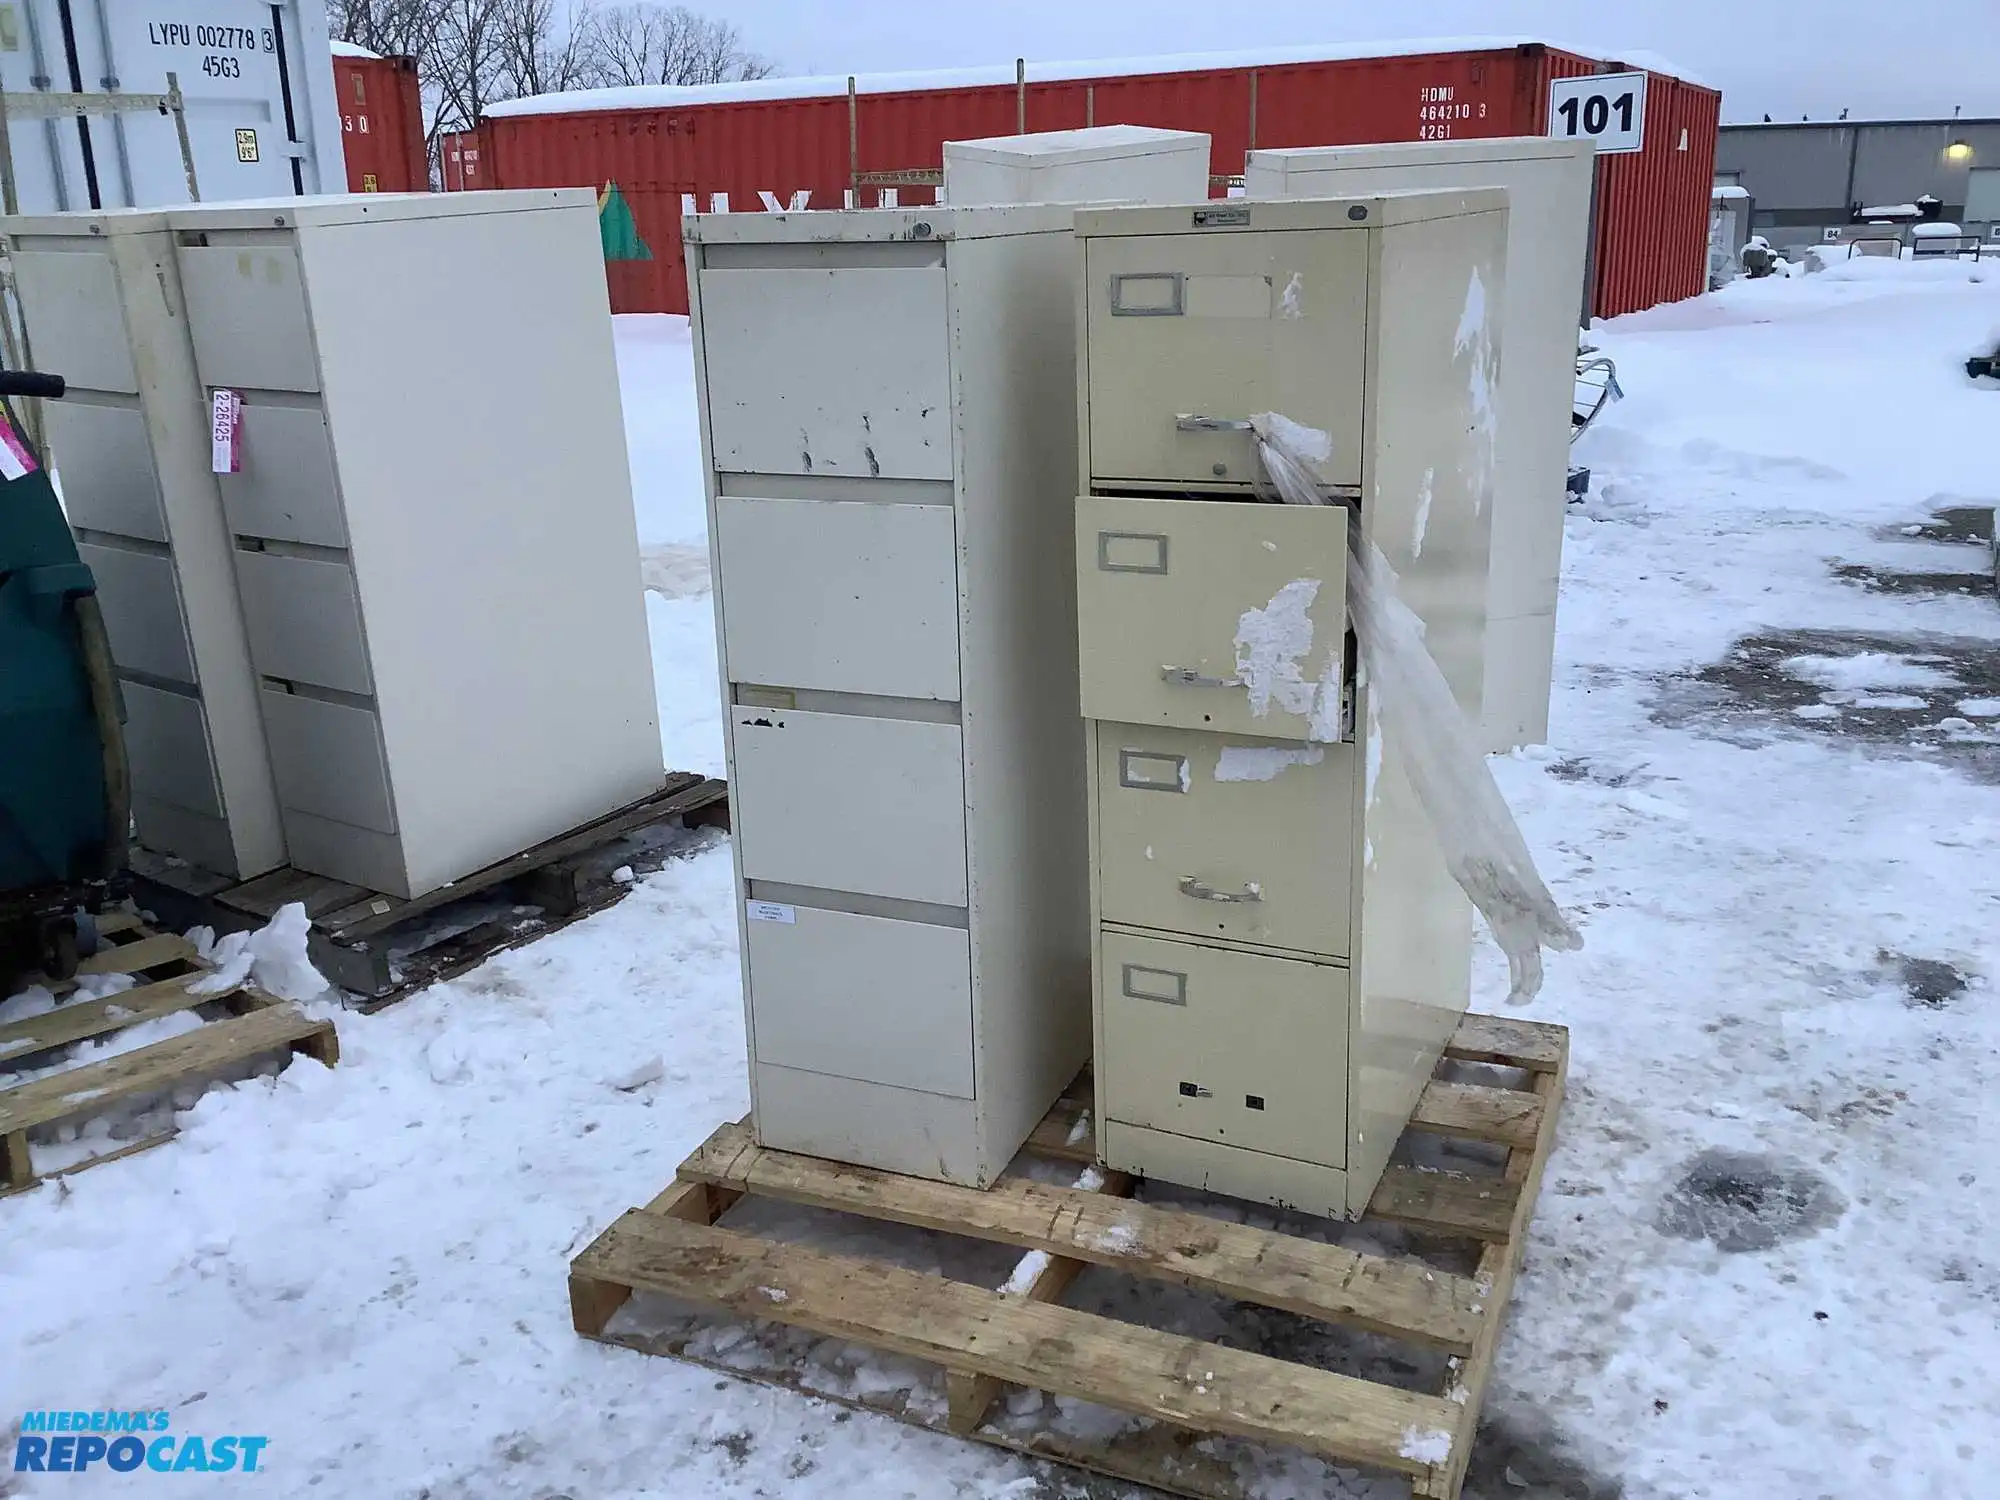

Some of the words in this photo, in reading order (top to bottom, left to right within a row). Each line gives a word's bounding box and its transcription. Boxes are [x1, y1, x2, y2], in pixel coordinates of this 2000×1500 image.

[148, 22, 190, 46] LYPU
[197, 25, 255, 50] 002778
[263, 30, 273, 51] 3
[202, 55, 240, 78] 45G3
[1421, 86, 1454, 102] HDMU
[1420, 103, 1470, 120] 464210
[1479, 103, 1486, 118] 3
[1558, 92, 1633, 136] 101
[1419, 124, 1451, 139] 42G1
[215, 393, 229, 442] 2-26425
